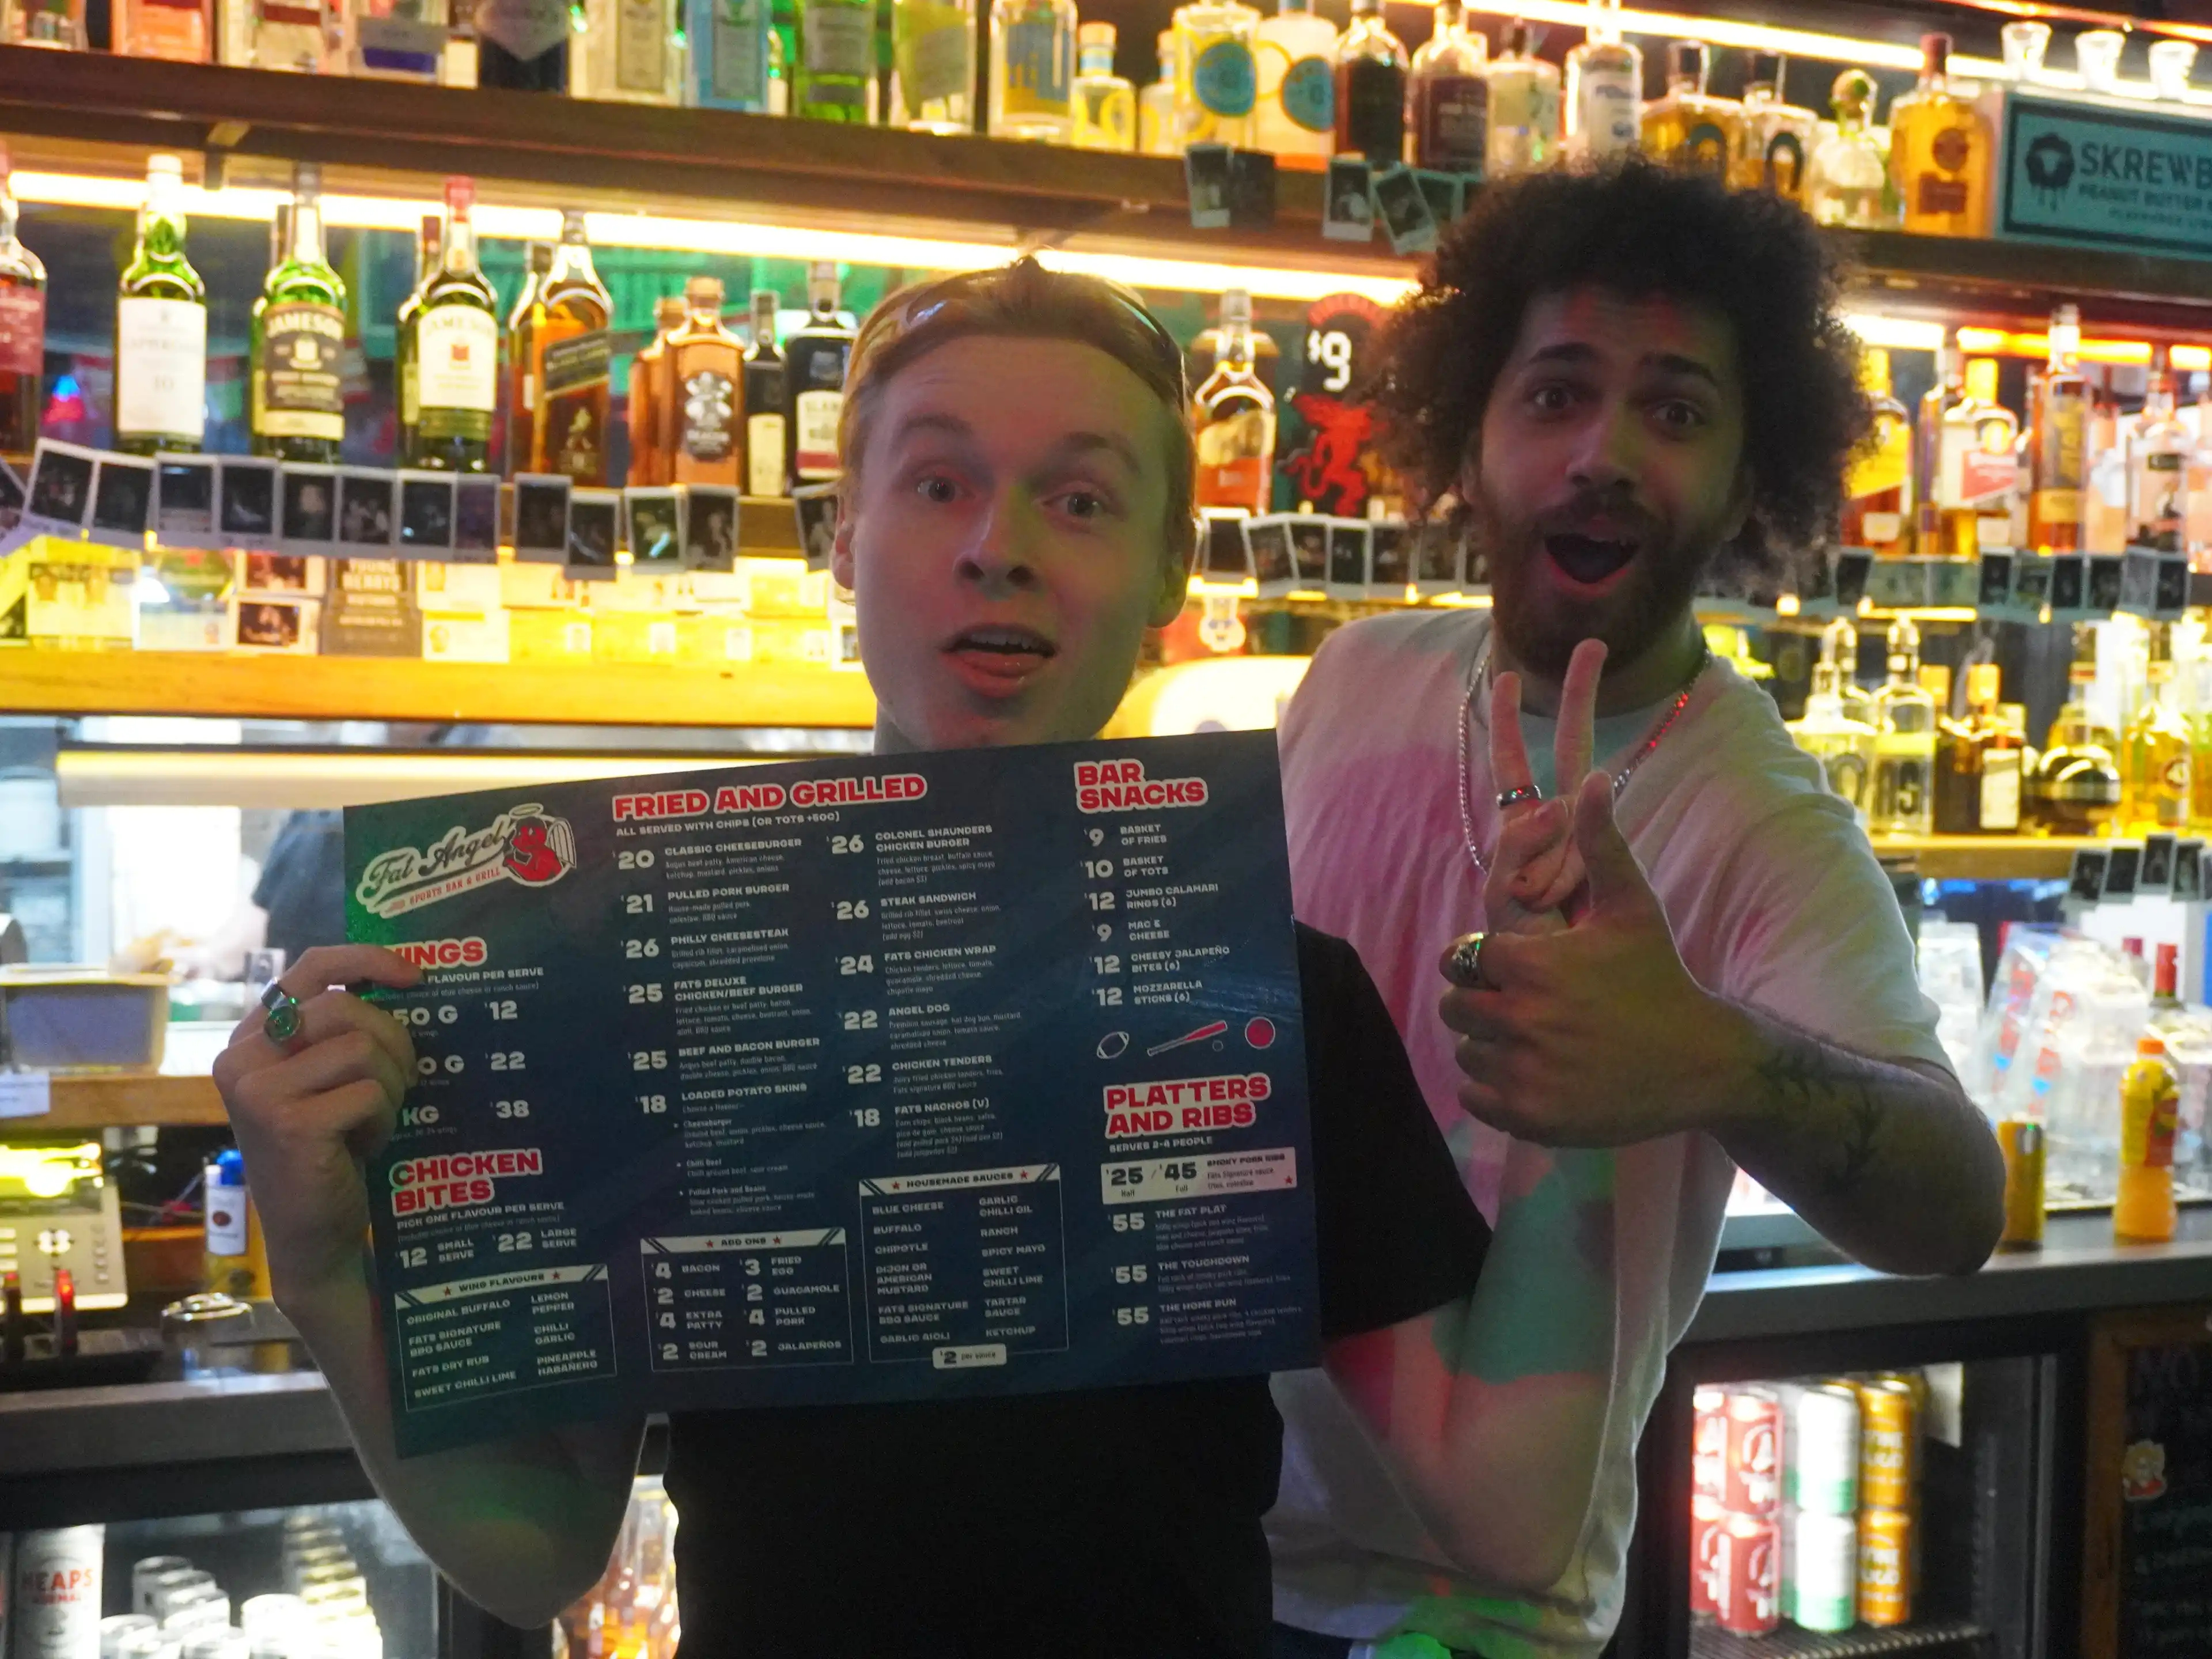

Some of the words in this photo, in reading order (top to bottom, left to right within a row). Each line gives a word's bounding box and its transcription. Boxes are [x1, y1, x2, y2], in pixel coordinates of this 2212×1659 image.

[267, 312, 344, 341] JAMESON
[1308, 329, 1353, 392] $9
[1077, 762, 1142, 787] BAR
[613, 791, 709, 821] FRIED
[715, 786, 785, 812] AND
[791, 775, 926, 807] GRILLED
[1079, 781, 1206, 810] SNACKS
[616, 827, 637, 837] ALL
[639, 824, 683, 835] SERVED
[684, 821, 714, 831] WITH
[715, 819, 750, 829] CHIPS
[752, 816, 772, 828] (OR
[775, 815, 805, 825] TOTS
[875, 830, 925, 841] COLONEL
[927, 824, 993, 837] SHAUNDERS
[1120, 824, 1161, 835] BASKET
[664, 844, 712, 856] CLASSIC
[715, 838, 802, 853] CHEESEBURGER
[876, 840, 925, 853] CHICKEN
[926, 838, 970, 849] BURGER
[1121, 836, 1135, 846] OF
[1137, 835, 1167, 845] FRIES
[418, 821, 514, 876] Angel
[895, 855, 922, 864] chicken
[1123, 855, 1164, 866] BASKET
[1124, 868, 1138, 878] OF
[1140, 866, 1169, 876] TOTS
[410, 887, 442, 905] SPORTS
[446, 881, 463, 893] BAR
[476, 869, 500, 882] GRILL
[668, 889, 710, 900] PULLED
[712, 887, 743, 897] PORK
[745, 883, 790, 895] BURGER
[1126, 887, 1163, 898] JUMBO
[1165, 883, 1218, 895] CALAMARI
[880, 896, 916, 907] STEAK
[918, 892, 976, 904] SANDWICH
[1126, 899, 1159, 910] RINGS
[1128, 920, 1151, 930] MAC
[671, 934, 707, 945] PHILLY
[710, 928, 789, 942] CHEESESTEAK
[1129, 930, 1170, 941] CHEESE
[884, 951, 912, 962] FATS
[914, 948, 962, 959] CHICKEN
[964, 945, 997, 955] WRAP
[1131, 950, 1172, 962] CHEESY
[1175, 945, 1230, 958] JALAPEÑO
[1131, 962, 1162, 973] BITES
[427, 972, 480, 984] FLAVOUR
[482, 969, 505, 980] PER
[507, 967, 544, 978] SERVE
[673, 979, 702, 990] FATS
[704, 976, 747, 988] DELUXE
[675, 987, 756, 1002] CHICKEN/BEEF
[758, 983, 803, 995] BURGER
[1133, 979, 1203, 995] MOZZARELLA
[1134, 994, 1173, 1005] STICKS
[888, 1006, 925, 1017] ANGEL
[926, 1003, 950, 1014] DOG
[678, 1046, 705, 1057] BEEF
[709, 1044, 732, 1054] AND
[734, 1041, 773, 1052] BACON
[775, 1037, 820, 1049] BURGER
[892, 1059, 940, 1071] CHICKEN
[942, 1054, 993, 1067] TENDERS
[681, 1089, 725, 1101] LOADED
[727, 1085, 772, 1097] POTATO
[774, 1082, 807, 1093] SKINS
[1105, 1075, 1269, 1111] PLATTERS
[895, 1104, 922, 1115] FATS
[924, 1100, 970, 1112] NACHOS
[1108, 1109, 1174, 1135] AND
[1181, 1102, 1253, 1129] RIBS
[1109, 1141, 1150, 1153] SERVES
[1172, 1136, 1213, 1147] PEOPLE
[1207, 1158, 1237, 1166] SMOKY
[1239, 1156, 1263, 1164] PORK
[391, 1152, 540, 1187] CHICKEN
[907, 1176, 969, 1188] HOUSEMADE
[973, 1172, 1013, 1183] SAUCES
[393, 1179, 492, 1214] BITES
[1121, 1189, 1135, 1197] Half
[1175, 1184, 1188, 1192] Full
[872, 1205, 900, 1215] BLUE
[902, 1201, 944, 1213] CHEESE
[979, 1195, 1018, 1206] GARLIC
[979, 1206, 1014, 1217] CHILLI
[1016, 1205, 1033, 1214] OIL
[873, 1223, 922, 1234] BUFFALO
[980, 1226, 1018, 1237] RANCH
[874, 1243, 928, 1255] CHIPOTLE
[981, 1247, 1013, 1257] SPICY
[1016, 1244, 1046, 1254] MAYO
[681, 1264, 720, 1273] BACON
[1158, 1262, 1178, 1271] THE
[1181, 1255, 1249, 1269] TOUCHDOWN
[459, 1281, 487, 1292] WING
[490, 1274, 547, 1290] FLAVOURS
[773, 1284, 840, 1295] GUACAMOLE
[531, 1291, 569, 1304] LEMON
[1159, 1303, 1180, 1312] THE
[1182, 1300, 1212, 1310] HOME
[1214, 1298, 1236, 1308] RUN
[406, 1308, 459, 1325] ORIGINAL
[461, 1299, 510, 1316] BUFFALO
[532, 1302, 574, 1315] PEPPER
[986, 1325, 1036, 1337] KETCHUP
[414, 1383, 452, 1398] SWEET
[454, 1376, 490, 1389] CHILLI
[491, 1370, 516, 1383] LIME
